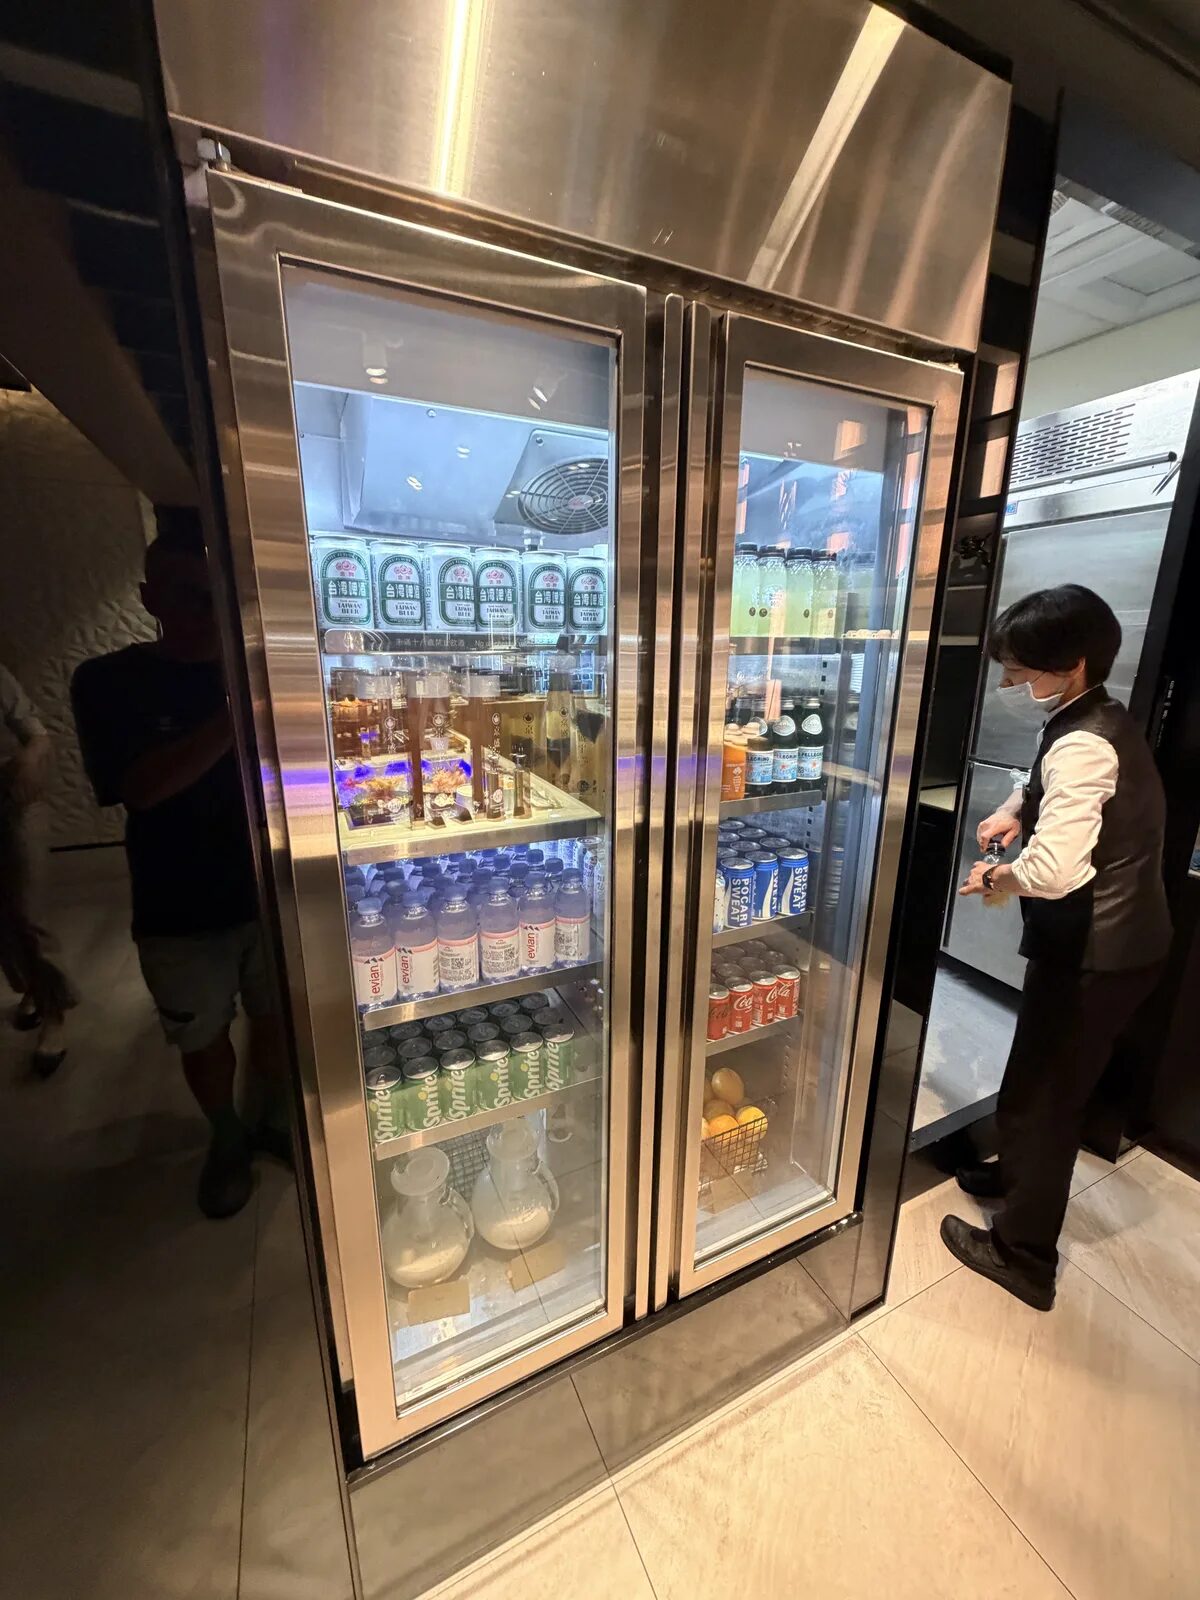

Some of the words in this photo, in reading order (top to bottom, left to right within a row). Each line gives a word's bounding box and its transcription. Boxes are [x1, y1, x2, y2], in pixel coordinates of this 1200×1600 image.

[328, 580, 367, 597] 台灣啤酒
[730, 879, 741, 922] SWEAT
[740, 878, 750, 926] POCARI
[771, 868, 779, 910] SWEAT
[792, 867, 803, 909] SWEAT
[800, 865, 808, 912] POCARI
[527, 932, 536, 959] evian
[370, 964, 381, 994] evian
[401, 955, 410, 984] evian
[448, 1069, 470, 1119] Sprite
[493, 1056, 511, 1107] Sprite
[524, 1050, 544, 1098] Sprite
[373, 1089, 397, 1142] Sprite
[421, 1074, 442, 1127] Sprite
